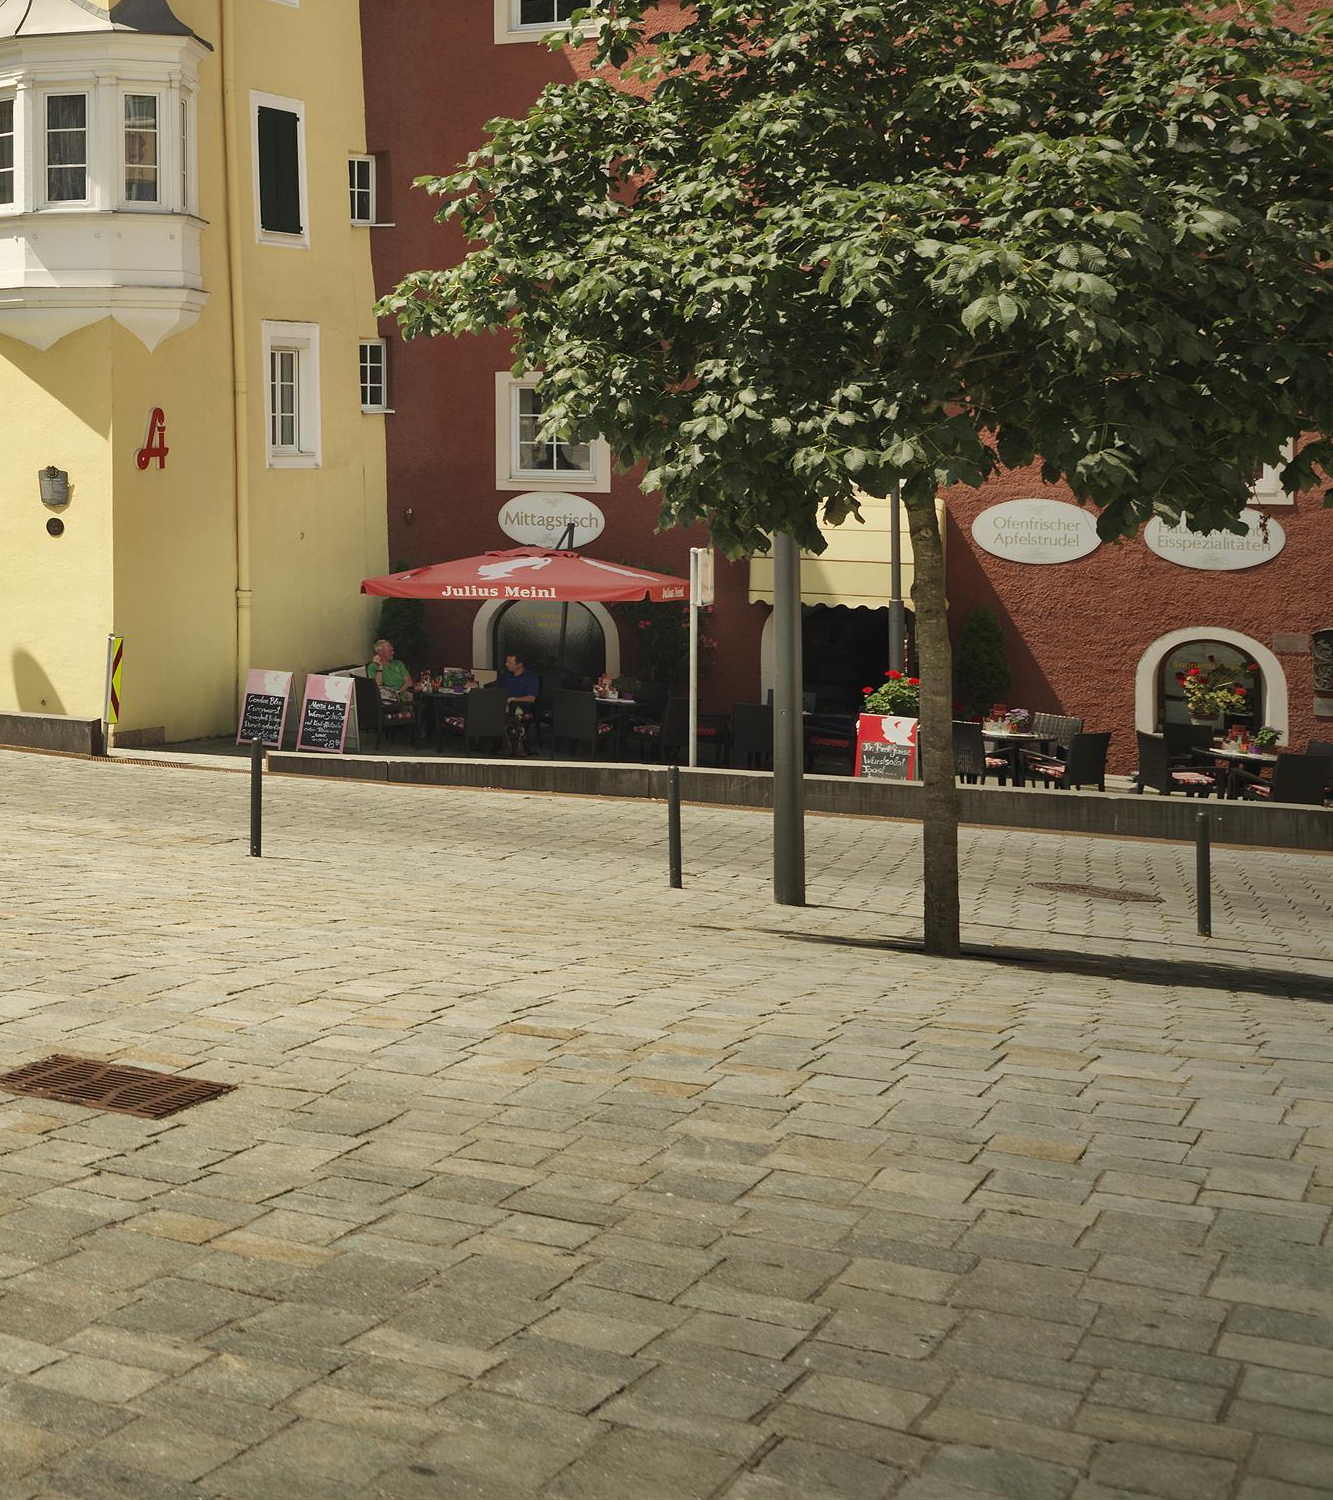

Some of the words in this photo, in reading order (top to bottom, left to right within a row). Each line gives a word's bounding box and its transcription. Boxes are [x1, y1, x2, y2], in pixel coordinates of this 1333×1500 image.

[504, 511, 599, 531] Mittagstisch
[993, 516, 1081, 532] Ofenfrischer
[993, 532, 1080, 548] Apfelstrudel
[1158, 535, 1271, 552] Eisspezialitäten
[442, 585, 499, 598] Julius
[504, 585, 558, 599] Meinl
